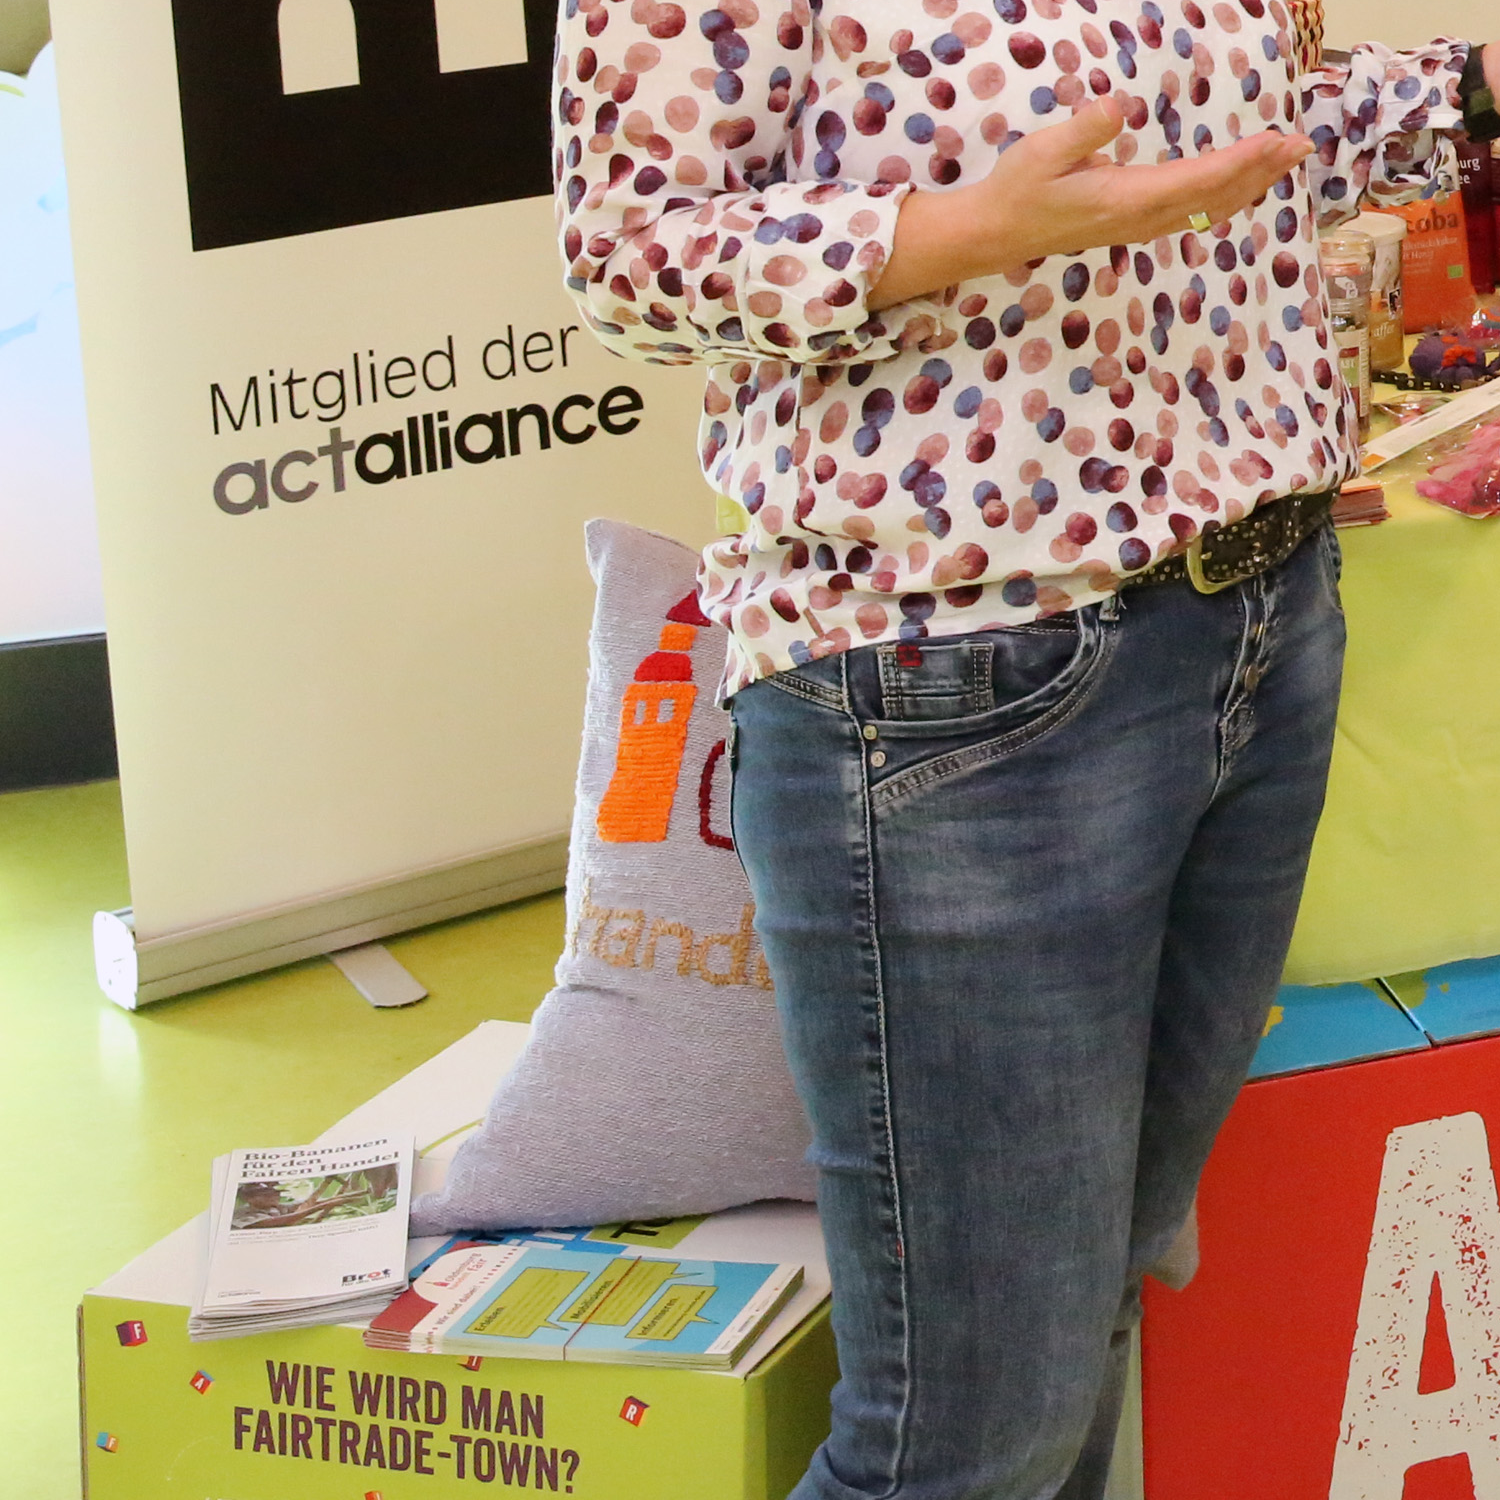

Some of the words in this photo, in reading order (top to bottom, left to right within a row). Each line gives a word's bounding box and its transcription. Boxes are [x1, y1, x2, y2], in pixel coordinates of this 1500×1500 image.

[1458, 156, 1481, 171] urg
[1458, 175, 1471, 185] ee
[211, 334, 457, 435] Mitglied
[483, 324, 579, 380] der
[213, 385, 644, 516] actalliance
[244, 1138, 388, 1161] Bio-Bananen
[240, 1166, 313, 1179] Fairen
[319, 1151, 400, 1172] Handel
[242, 1160, 274, 1170] für
[281, 1157, 323, 1168] den
[341, 1268, 392, 1284] Brot
[266, 1360, 334, 1412] WIE
[349, 1371, 447, 1426] WIRD
[461, 1385, 545, 1439] MAN
[233, 1406, 581, 1494] FAIRTRADE-TOWN?
